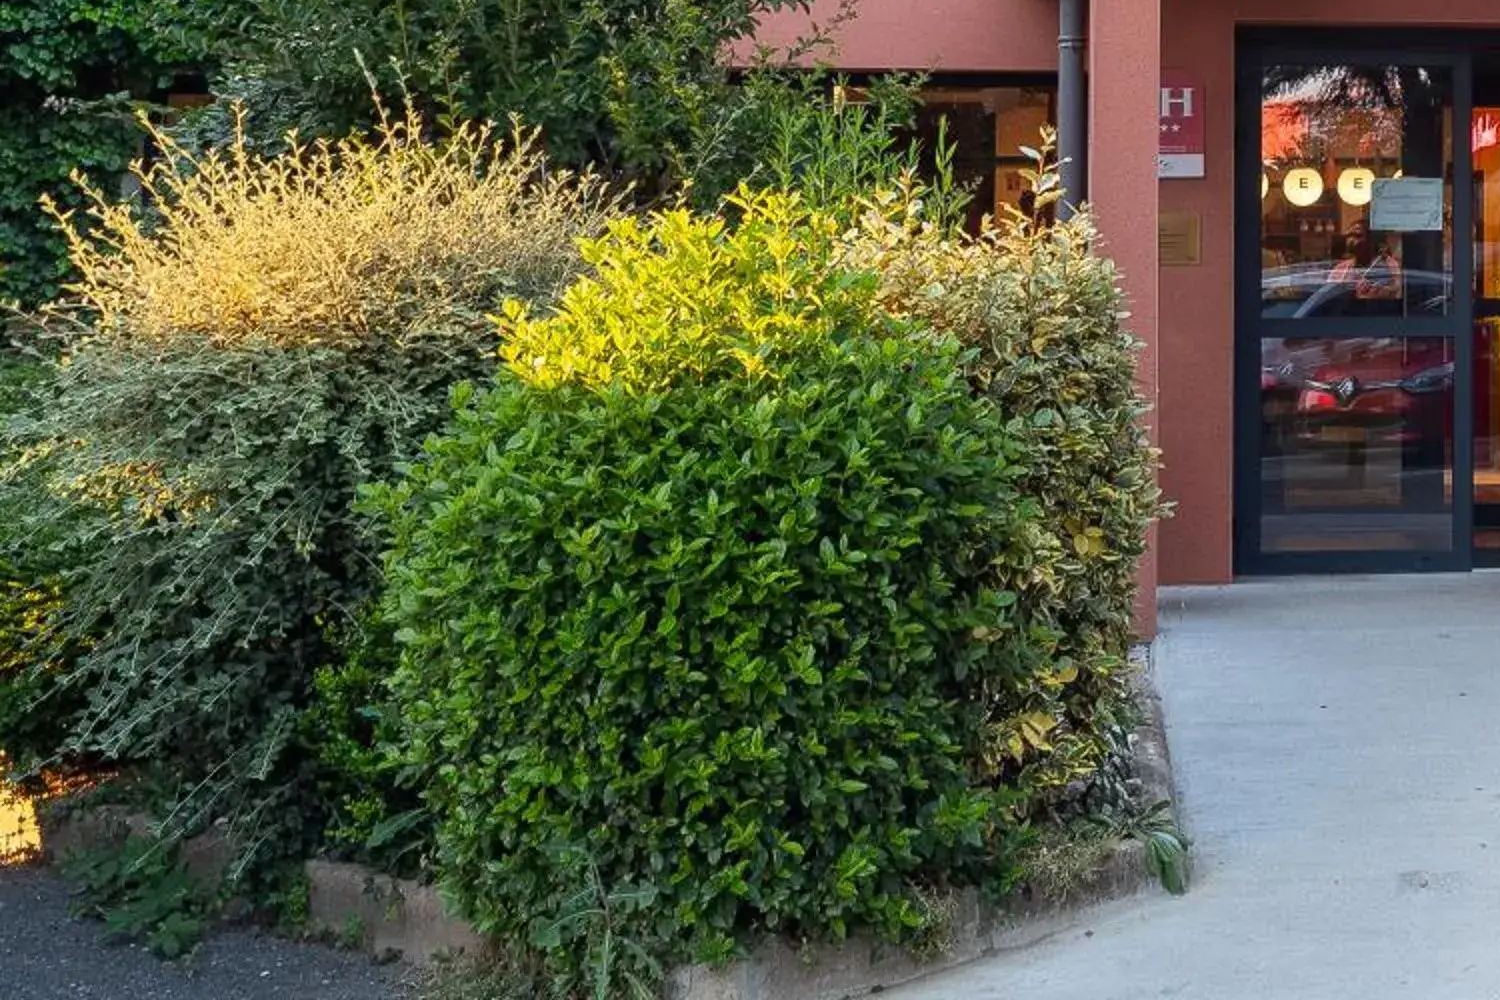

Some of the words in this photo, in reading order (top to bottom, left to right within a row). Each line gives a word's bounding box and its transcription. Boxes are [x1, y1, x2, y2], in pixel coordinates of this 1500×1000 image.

[1160, 87, 1195, 117] H
[1299, 177, 1309, 189] E
[1353, 177, 1364, 189] E
